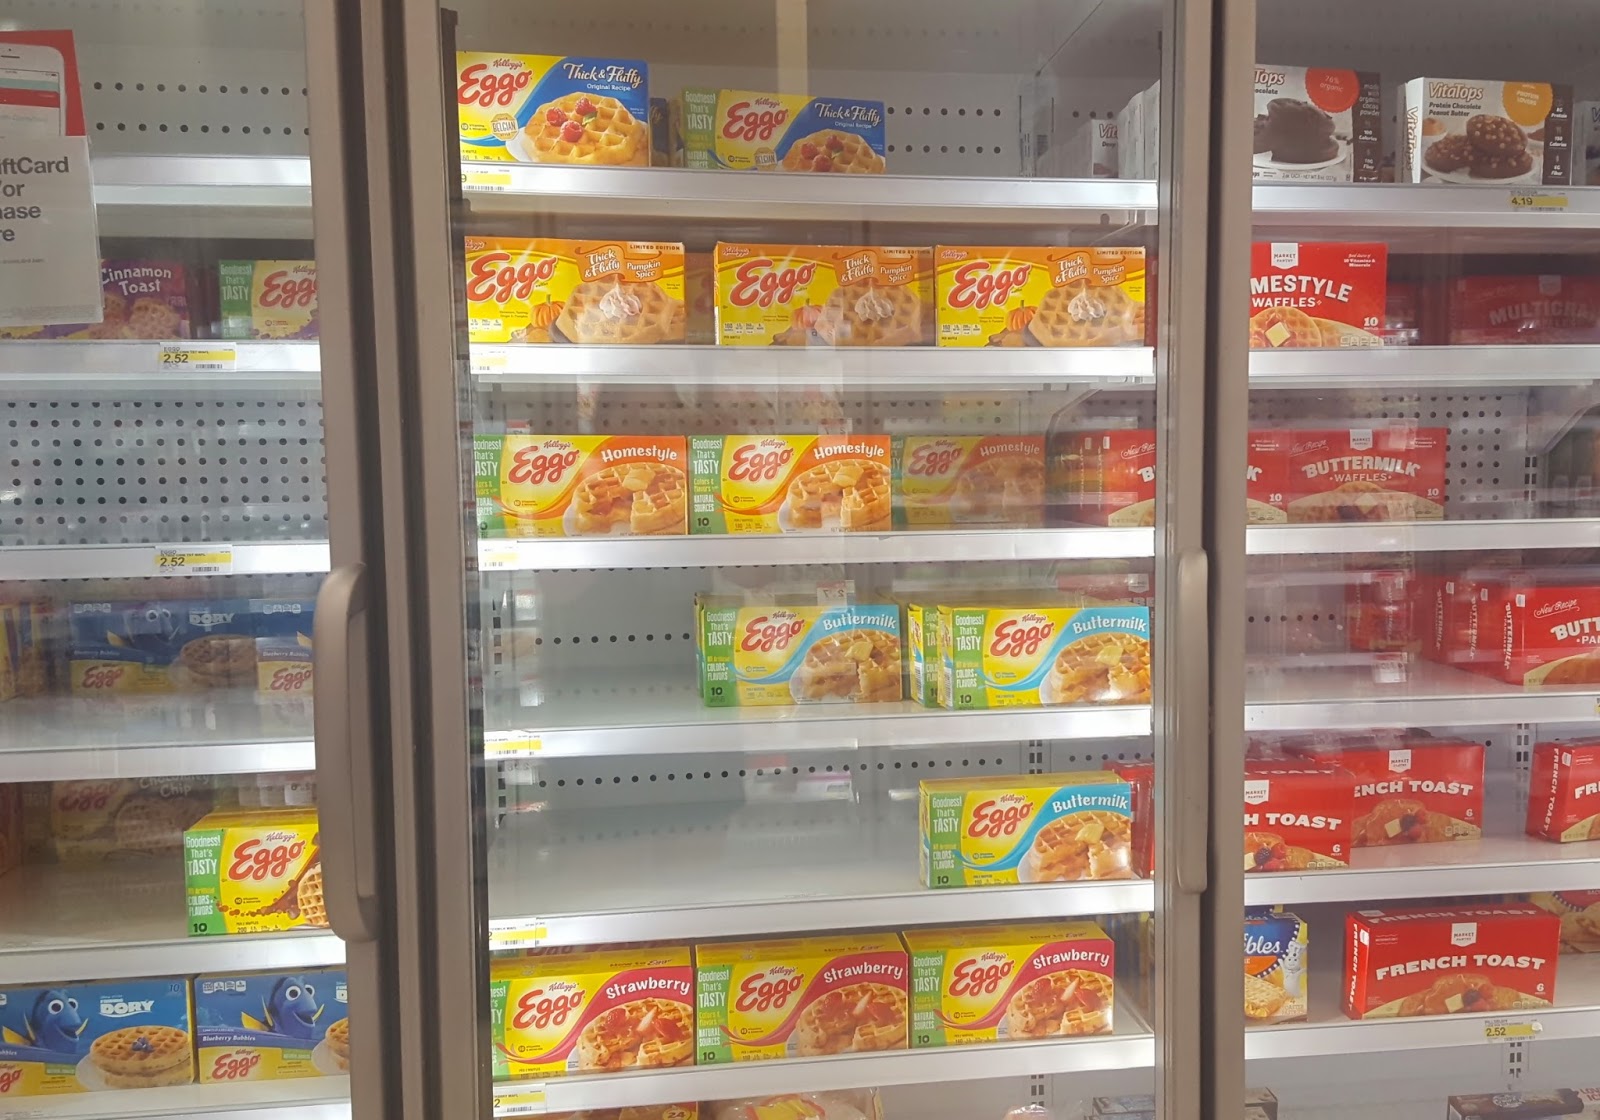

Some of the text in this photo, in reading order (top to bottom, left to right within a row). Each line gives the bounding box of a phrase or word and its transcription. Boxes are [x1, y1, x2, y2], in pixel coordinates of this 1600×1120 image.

[563, 63, 643, 89] Thick & Fluffy
[457, 63, 532, 107] Eggo
[587, 83, 631, 92] Original Recipe
[1429, 82, 1484, 101] VitaTops
[1452, 102, 1482, 110] Chocolate
[722, 101, 789, 141] Eggo
[815, 103, 845, 118] Thick
[850, 104, 881, 126] Fluffy
[493, 120, 516, 131] BELGIAN
[687, 114, 713, 131] TASTY
[1511, 197, 1533, 206] 4.19
[585, 249, 616, 266] Thick
[840, 255, 870, 270] Thick
[1057, 255, 1084, 271] Thick
[591, 260, 621, 277] Fluffy
[626, 260, 661, 273] Pumpkin
[847, 265, 874, 281] Fluffy
[880, 264, 913, 276] Pumpkin
[1061, 266, 1088, 282] Fluffy
[1093, 265, 1125, 276] Pumpkin
[101, 266, 172, 285] Cinnamon
[466, 252, 558, 303] Eggo
[635, 270, 656, 280] Spice
[888, 273, 907, 283] Spice
[1101, 273, 1119, 284] Spice
[119, 280, 162, 296] Toast
[259, 270, 318, 308] Egg
[730, 259, 817, 308] Eggo
[948, 261, 1032, 310] Eggo
[1250, 275, 1353, 303] MESTYLE
[222, 285, 249, 301] TASTY
[1252, 297, 1316, 308] WAFFLES
[1363, 316, 1379, 327] 10
[163, 354, 189, 363] 2.52
[692, 438, 722, 449] Goodness!
[814, 442, 884, 460] Homestyle
[980, 441, 1040, 457] Homestyle
[602, 445, 678, 463] Homestyle
[697, 451, 716, 459] That's
[908, 444, 963, 476] Eggo
[508, 446, 580, 485] Eggo
[693, 460, 719, 475] TASTY
[728, 445, 794, 482] Eggo
[1302, 456, 1420, 478] BUTTERMILK
[1334, 473, 1388, 482] WAFFLES
[1269, 493, 1283, 502] 10
[1426, 488, 1440, 497] 10
[697, 517, 710, 526] 10
[160, 557, 185, 567] 2.52
[189, 613, 235, 625] DORY
[823, 613, 897, 631] Buttermilk
[955, 615, 985, 626] Goodness!
[1072, 616, 1147, 634] Buttermilk
[707, 632, 733, 646] TASTY
[740, 616, 805, 653] Eggo
[960, 627, 978, 636] That's
[990, 620, 1054, 658] Eggo
[956, 636, 982, 651] TASTY
[83, 666, 124, 688] Eggo
[270, 668, 313, 690] Eggo
[711, 687, 723, 696] 10
[960, 694, 972, 703] 10
[1551, 748, 1559, 794] FRENCH
[160, 784, 192, 798] Chip
[1409, 780, 1473, 796] TOAST
[1052, 794, 1128, 814] Buttermilk
[937, 808, 955, 817] That's
[968, 800, 1034, 838] Eggo
[1466, 809, 1473, 817] 6
[933, 818, 959, 833] TASTY
[1266, 813, 1342, 830] TOAST
[186, 835, 221, 848] Goodness!
[266, 832, 296, 843] Kellogg's
[191, 849, 213, 858] That's
[1332, 844, 1341, 853] 6
[188, 859, 217, 876] TASTY
[228, 839, 305, 881] Eggo
[937, 876, 949, 884] 10
[1368, 908, 1539, 924] FRENCH TOAST
[193, 923, 208, 933] 10
[914, 955, 943, 967] Goodness!
[1033, 949, 1110, 970] Strawberry
[824, 962, 903, 984] Strawberry
[918, 968, 936, 977] That's
[1376, 954, 1545, 981] FRENCH TOAST
[698, 969, 729, 982] Goodness!
[949, 959, 1014, 997] Eggo
[169, 983, 180, 993] 10
[606, 977, 691, 999] Strawberry
[703, 983, 722, 992] That's
[735, 973, 804, 1012] Eggo
[914, 977, 940, 993] TASTY
[1537, 983, 1544, 992] 6
[699, 992, 726, 1008] TASTY
[100, 1001, 155, 1015] DORY
[513, 990, 586, 1029] Eggo
[918, 1035, 930, 1044] 10
[1486, 1027, 1506, 1037] 2.52
[703, 1051, 715, 1060] 10
[212, 1053, 261, 1080] Eggo
[668, 1111, 686, 1119] 24
